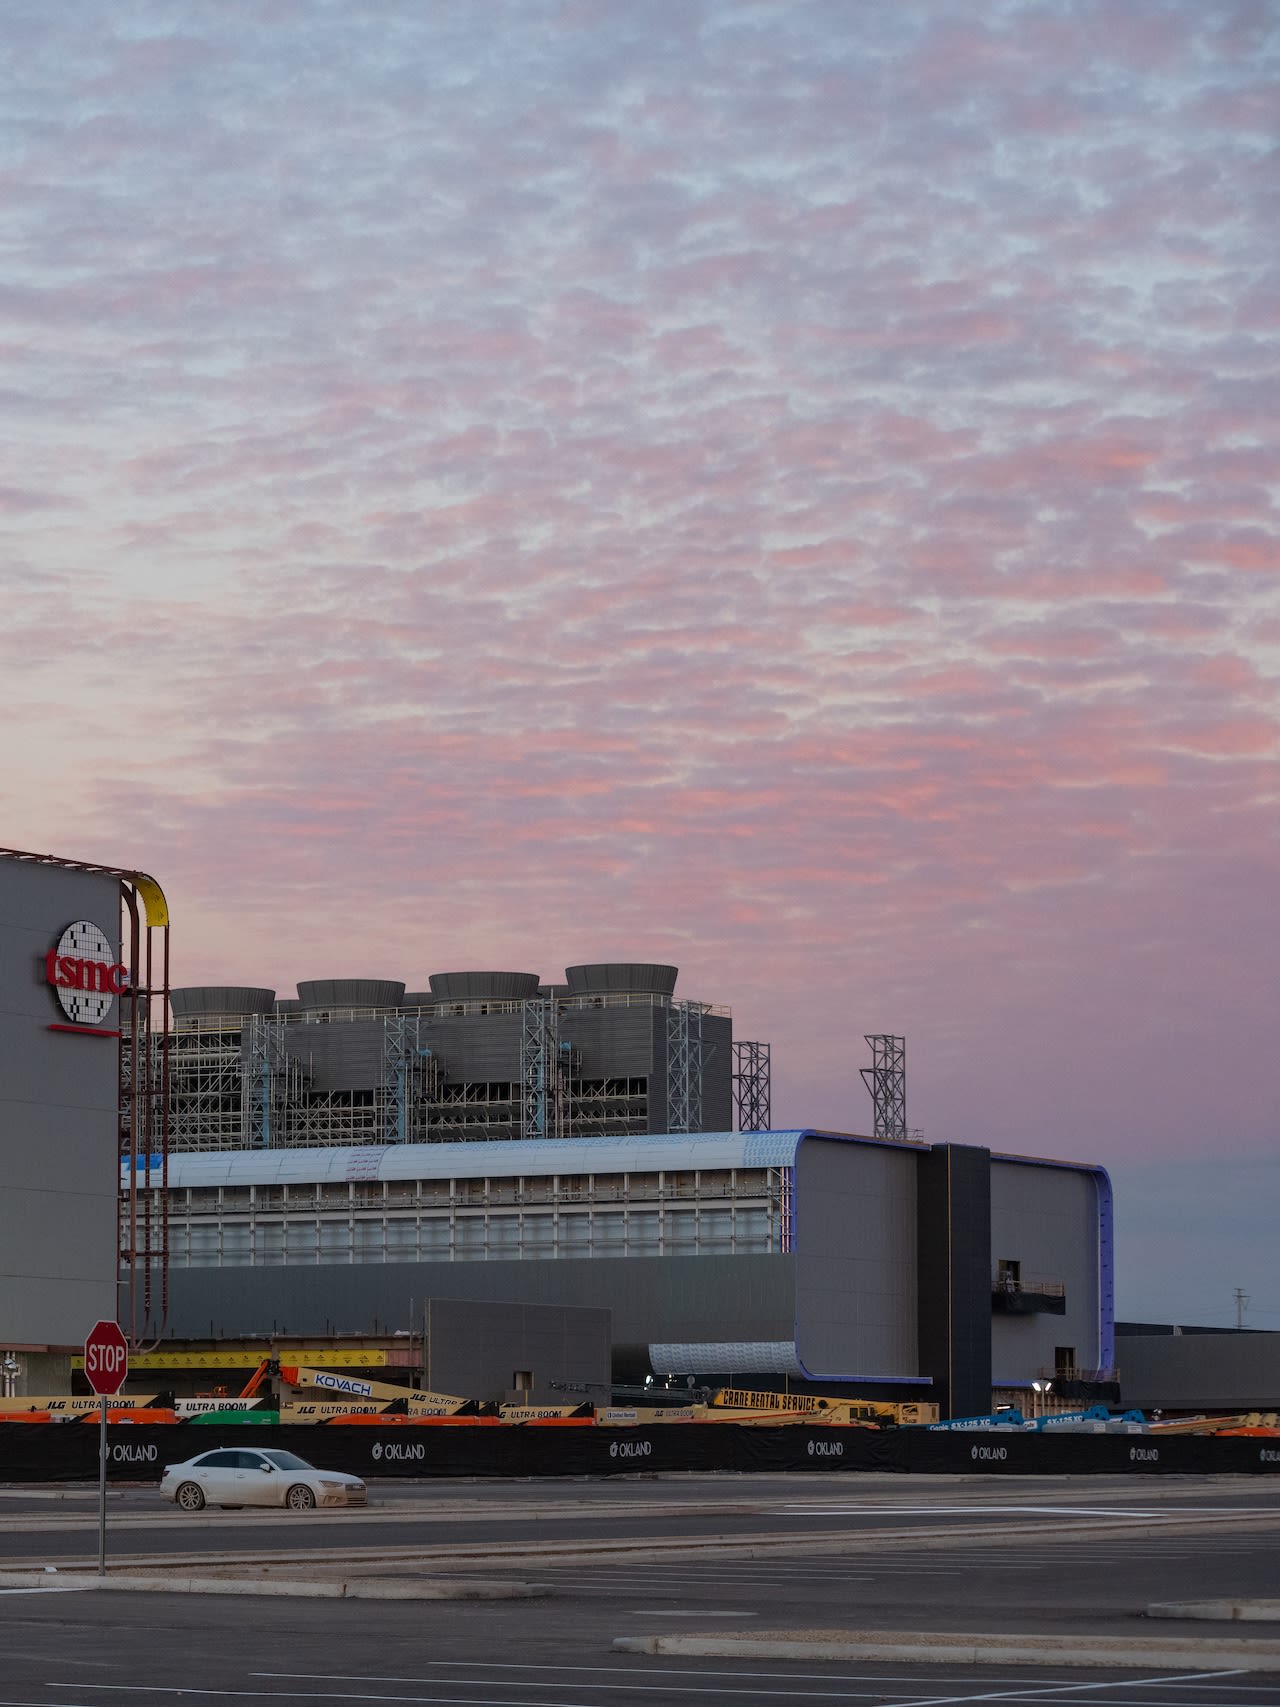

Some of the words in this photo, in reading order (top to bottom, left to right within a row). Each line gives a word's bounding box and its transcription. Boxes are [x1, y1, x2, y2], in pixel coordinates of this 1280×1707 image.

[45, 948, 128, 995] tsmc
[88, 1343, 125, 1373] STOP
[315, 1374, 371, 1396] KOVACH
[72, 1401, 102, 1409] ULTRA
[410, 1393, 427, 1402] JLG
[723, 1390, 749, 1407] CRANE
[751, 1392, 780, 1409] RENTAL
[782, 1395, 816, 1411] SERVICE
[186, 1403, 216, 1411] ULTRA
[218, 1403, 247, 1411] BOOM
[297, 1406, 317, 1414] JLG
[320, 1406, 347, 1414] ULTRA
[350, 1406, 377, 1415] BOOM
[510, 1411, 536, 1419] ULTRA
[538, 1410, 562, 1418] BOOM
[113, 1444, 158, 1462] OKLAND
[384, 1444, 426, 1460] OKLAND
[620, 1441, 652, 1457] OKLAND
[815, 1442, 844, 1456] OKLAND
[978, 1446, 1008, 1460] OKLAND
